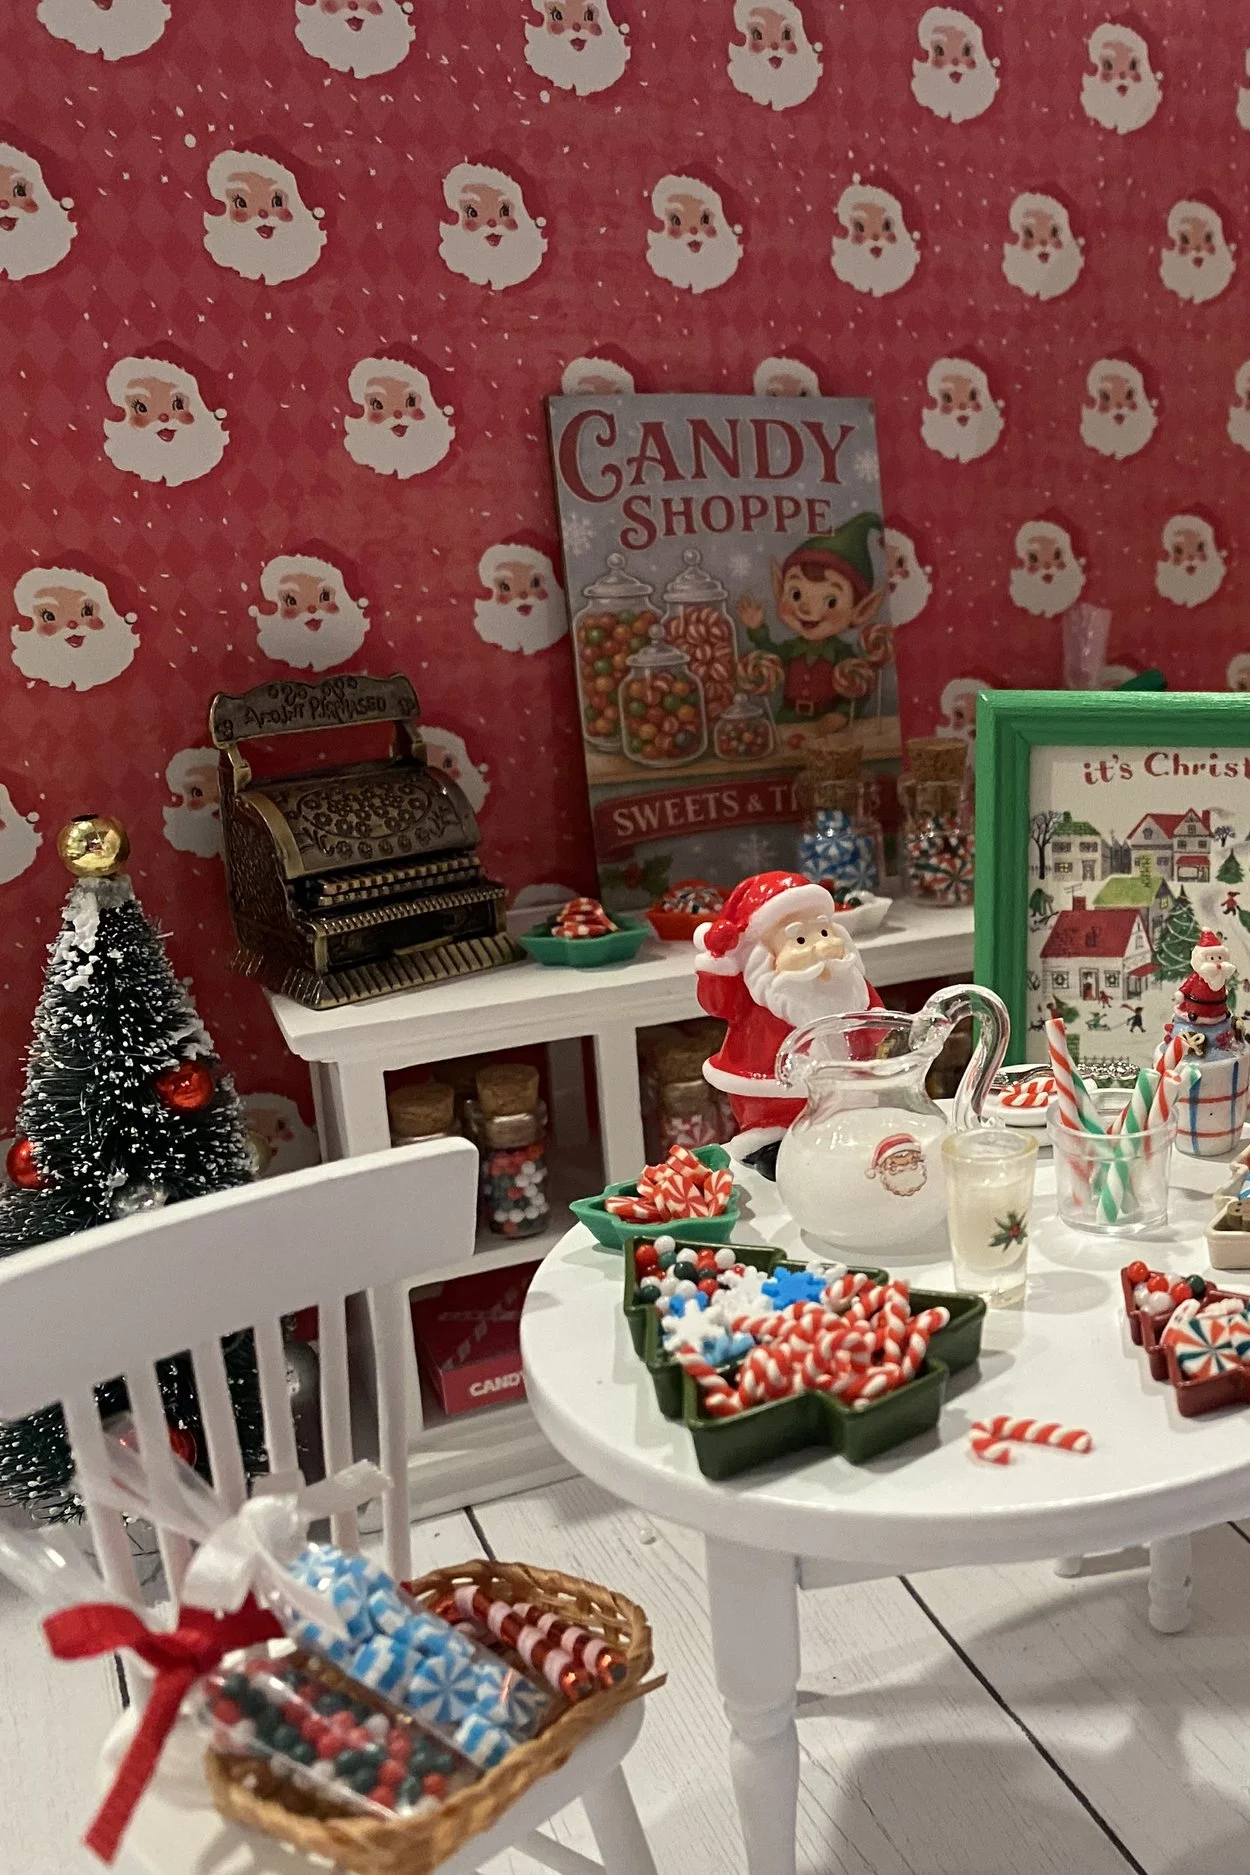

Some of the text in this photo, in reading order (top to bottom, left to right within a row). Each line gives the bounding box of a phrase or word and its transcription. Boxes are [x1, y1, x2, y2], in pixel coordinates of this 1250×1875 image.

[557, 409, 855, 503] CANDY
[619, 494, 834, 550] SHOPPE
[1083, 753, 1134, 785] it's
[612, 790, 740, 837] SWEETS
[749, 792, 765, 812] &
[469, 1371, 524, 1397] CAND
